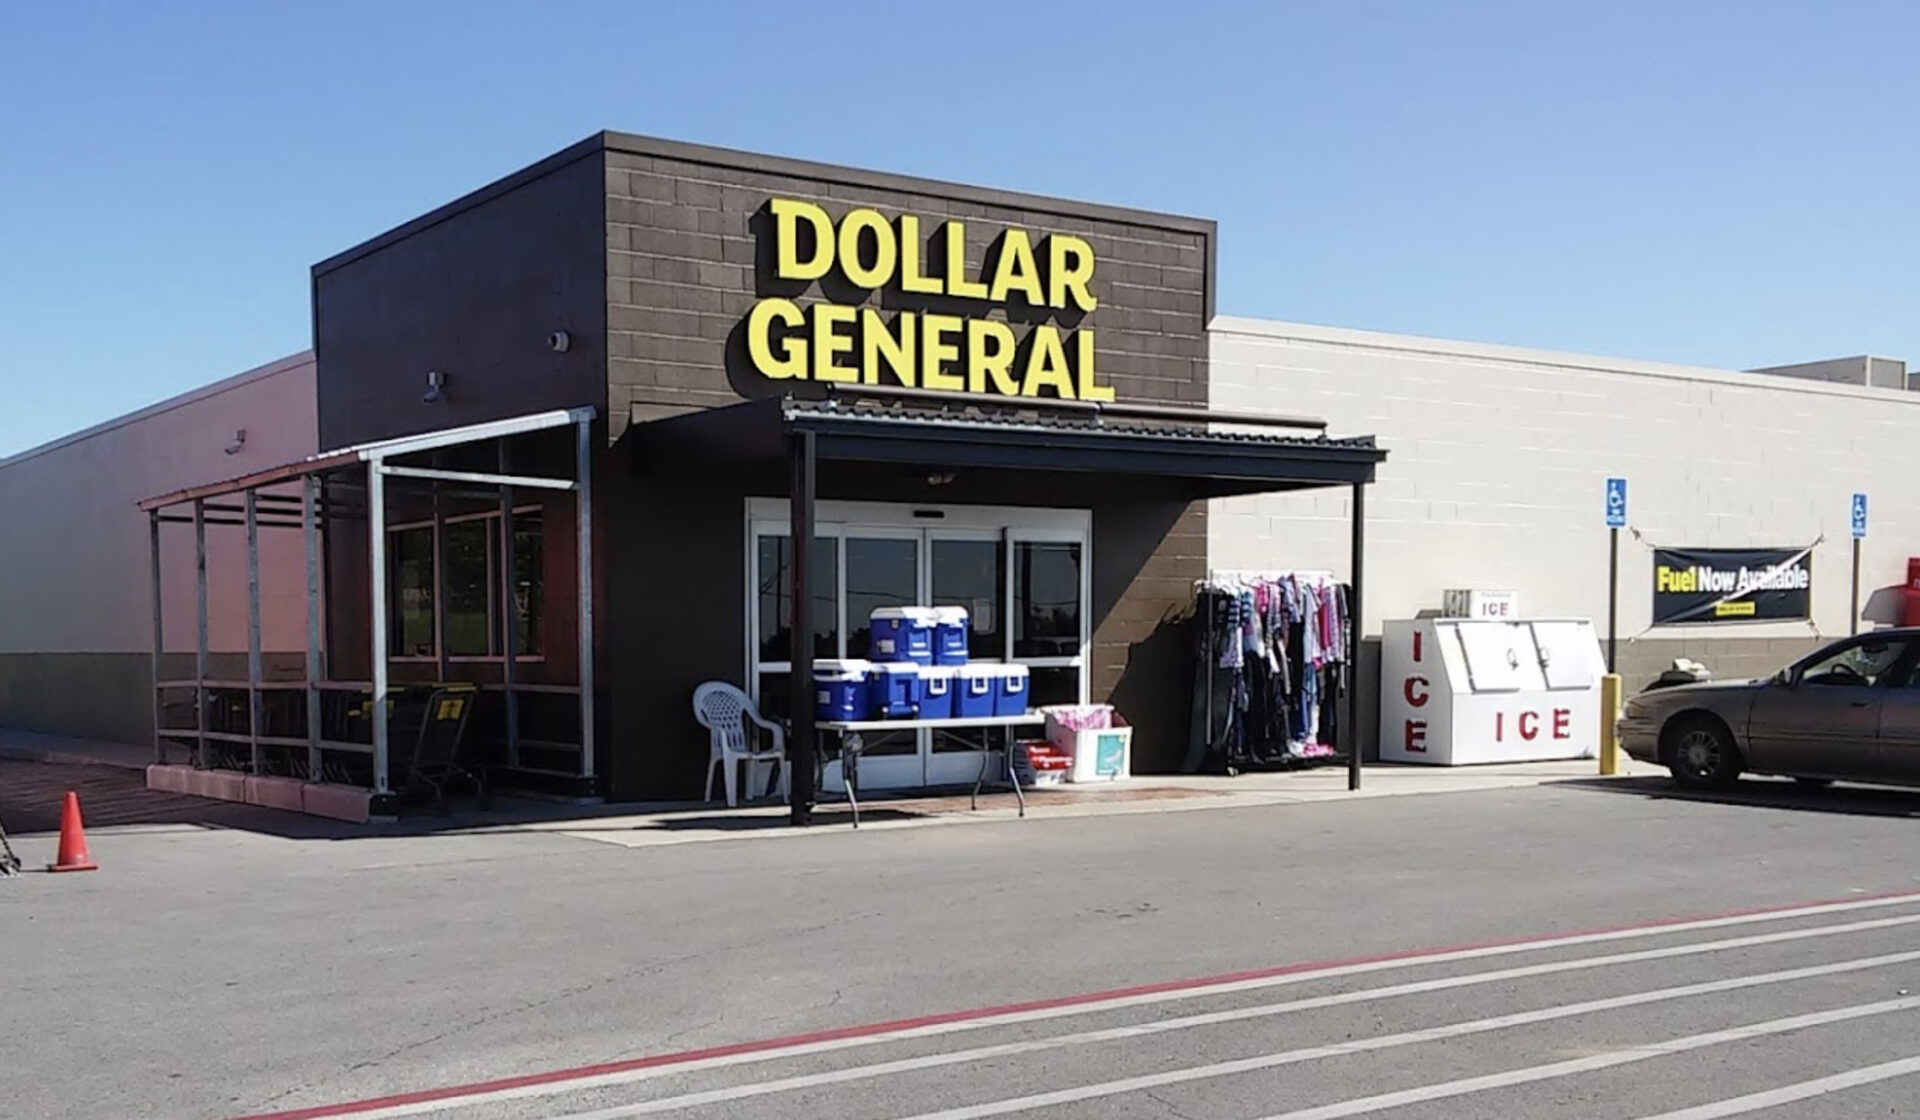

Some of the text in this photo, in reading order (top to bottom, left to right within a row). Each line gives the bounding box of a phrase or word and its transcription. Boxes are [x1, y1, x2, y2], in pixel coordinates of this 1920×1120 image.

[771, 197, 1098, 312] DOLLAR
[747, 297, 1116, 403] GENERAL
[1482, 602, 1509, 616] ICE
[1657, 563, 1809, 592] Fuel Now Available
[1404, 631, 1430, 753] ICE
[1496, 708, 1571, 742] ICE
